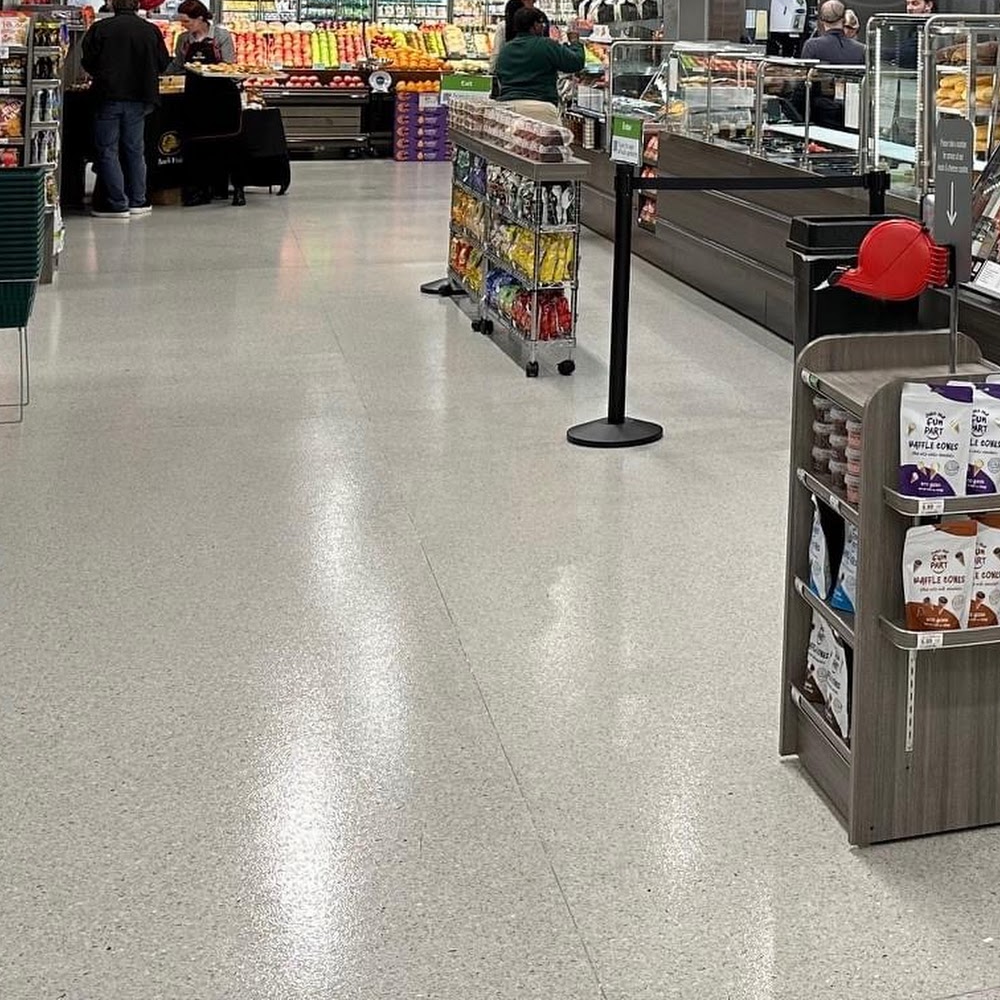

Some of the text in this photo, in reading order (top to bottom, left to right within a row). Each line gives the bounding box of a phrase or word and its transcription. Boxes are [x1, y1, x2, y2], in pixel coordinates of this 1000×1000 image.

[927, 418, 943, 426] FUN
[924, 426, 944, 435] PART
[909, 441, 958, 450] WAFFLE CONES
[913, 575, 965, 585] WAFFLE CONES
